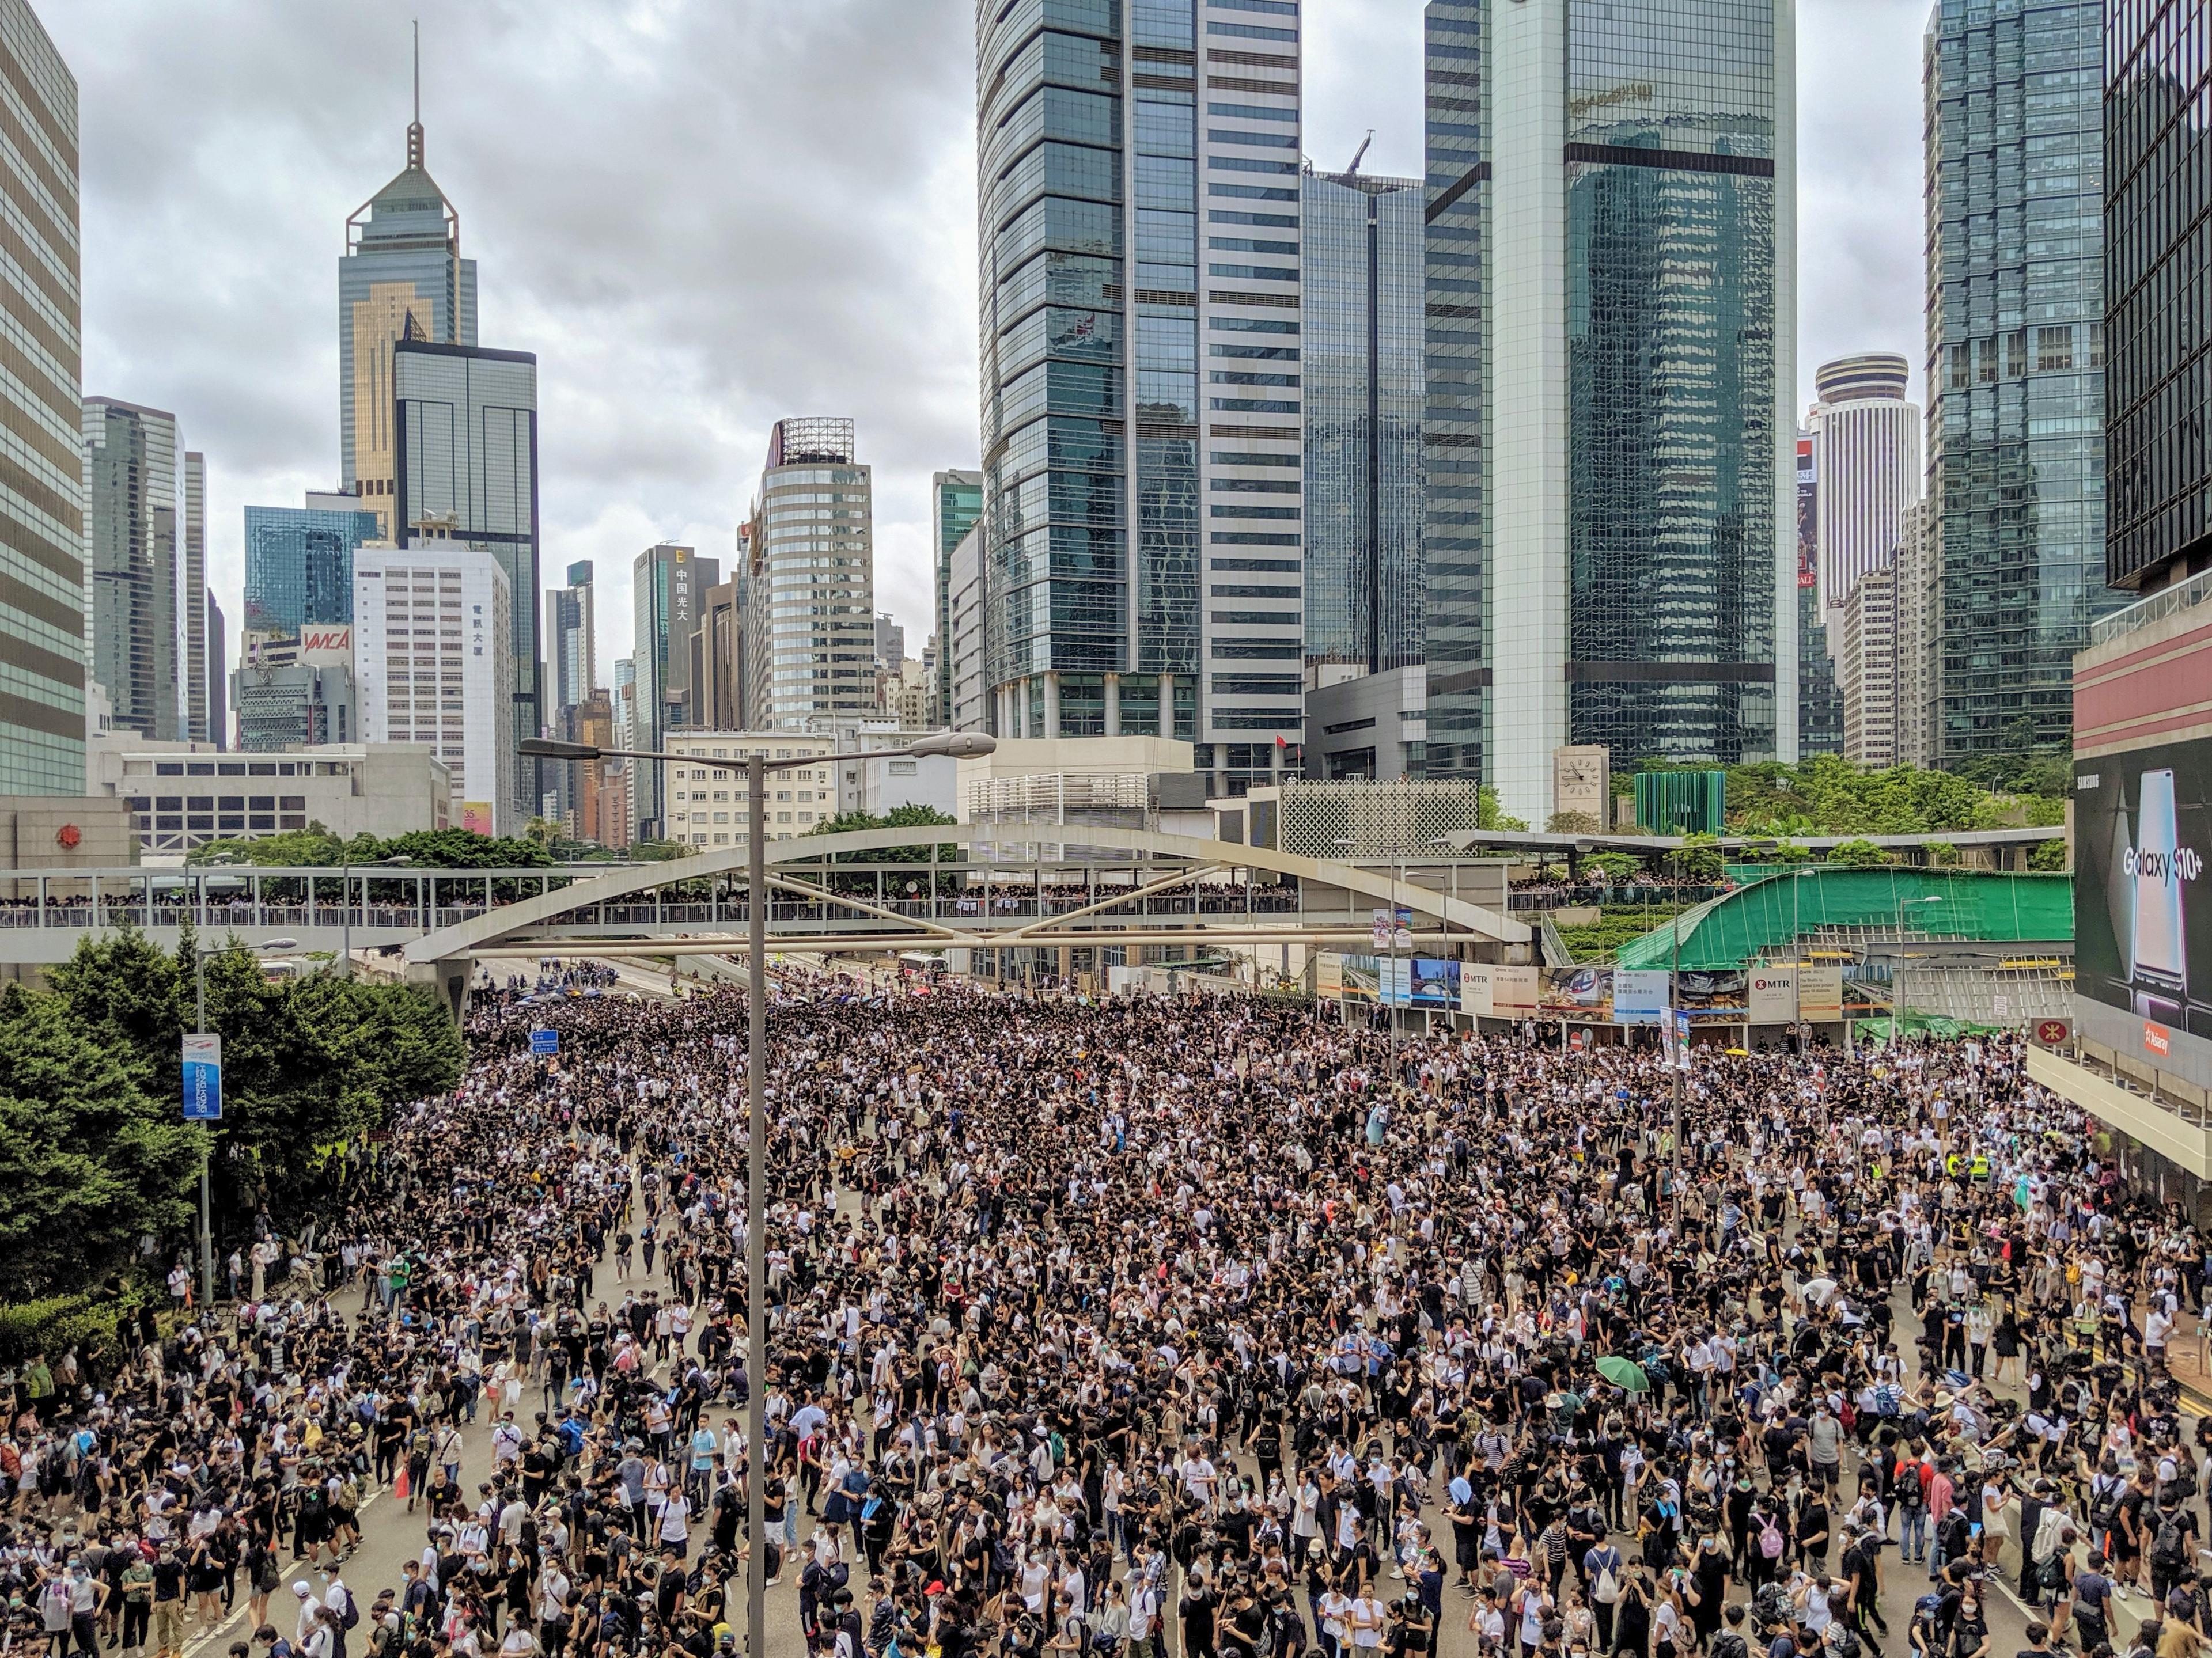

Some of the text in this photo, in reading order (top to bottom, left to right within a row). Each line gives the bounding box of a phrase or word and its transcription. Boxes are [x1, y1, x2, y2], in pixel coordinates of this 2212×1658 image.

[676, 569, 688, 621] 中国光大
[473, 605, 483, 656] 電訊大廈
[304, 629, 349, 654] YMCA
[2077, 773, 2099, 790] SAMSUNG
[464, 810, 474, 818] 35
[2123, 846, 2203, 887] Galaxy S10+
[1470, 975, 1487, 984] MTR
[1768, 980, 1790, 988] MTR
[2151, 1034, 2168, 1055] Asiaray
